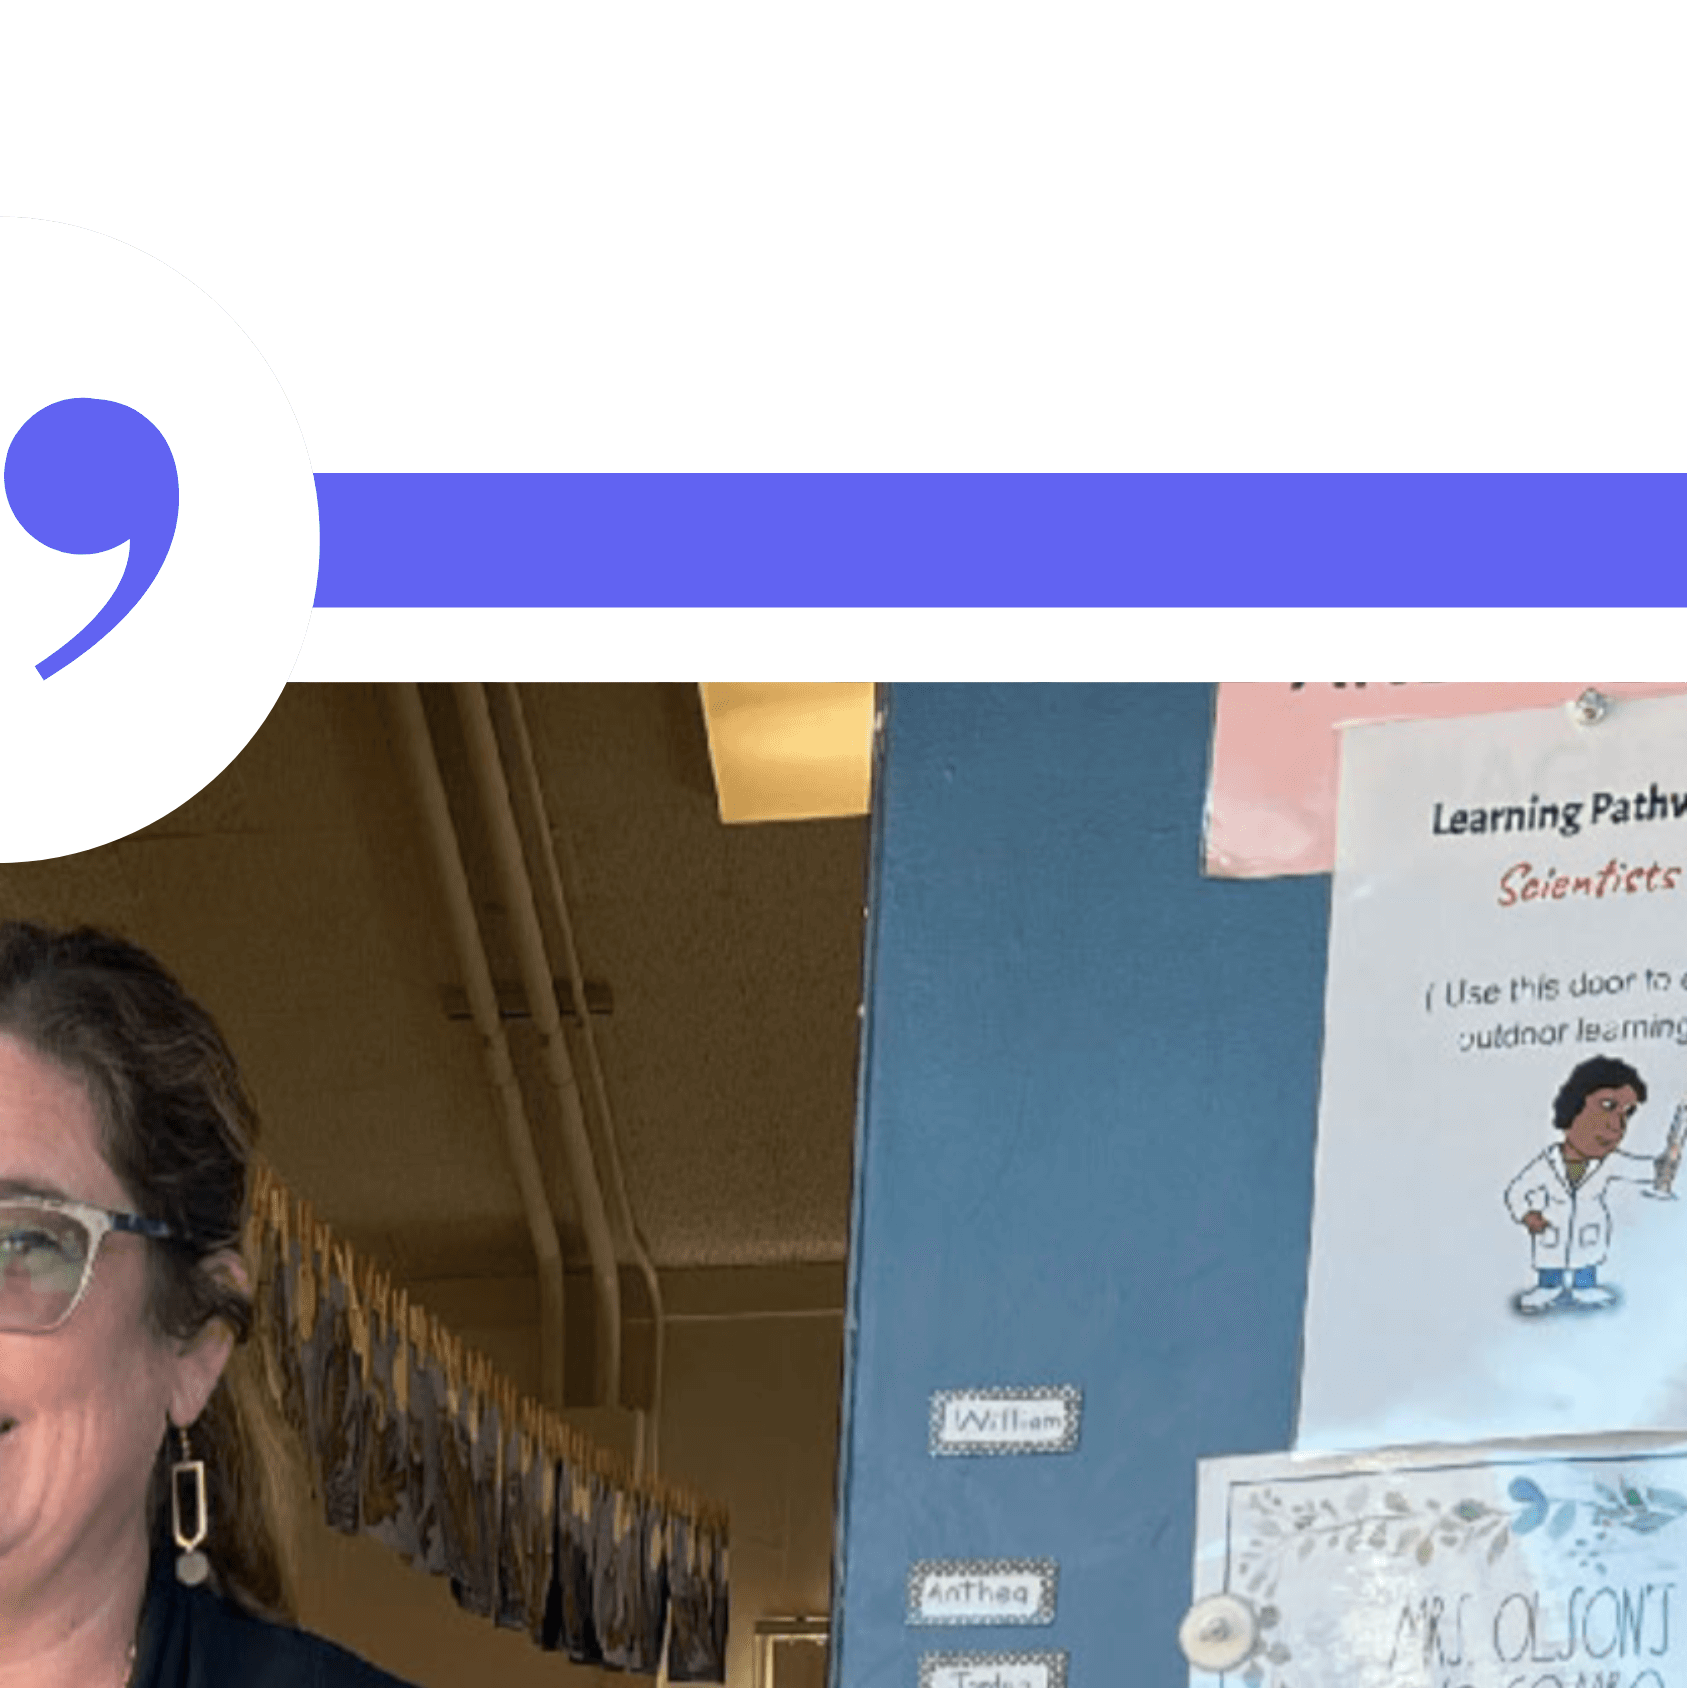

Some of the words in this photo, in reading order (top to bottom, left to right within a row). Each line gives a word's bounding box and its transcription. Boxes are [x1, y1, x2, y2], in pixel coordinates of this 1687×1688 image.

[1432, 792, 1585, 837] Learning
[1497, 858, 1682, 907] Scientists
[1445, 977, 1501, 1008] Use
[1510, 973, 1560, 1003] this
[1568, 971, 1638, 998] door
[1645, 968, 1672, 992] to
[954, 1408, 1063, 1432] William
